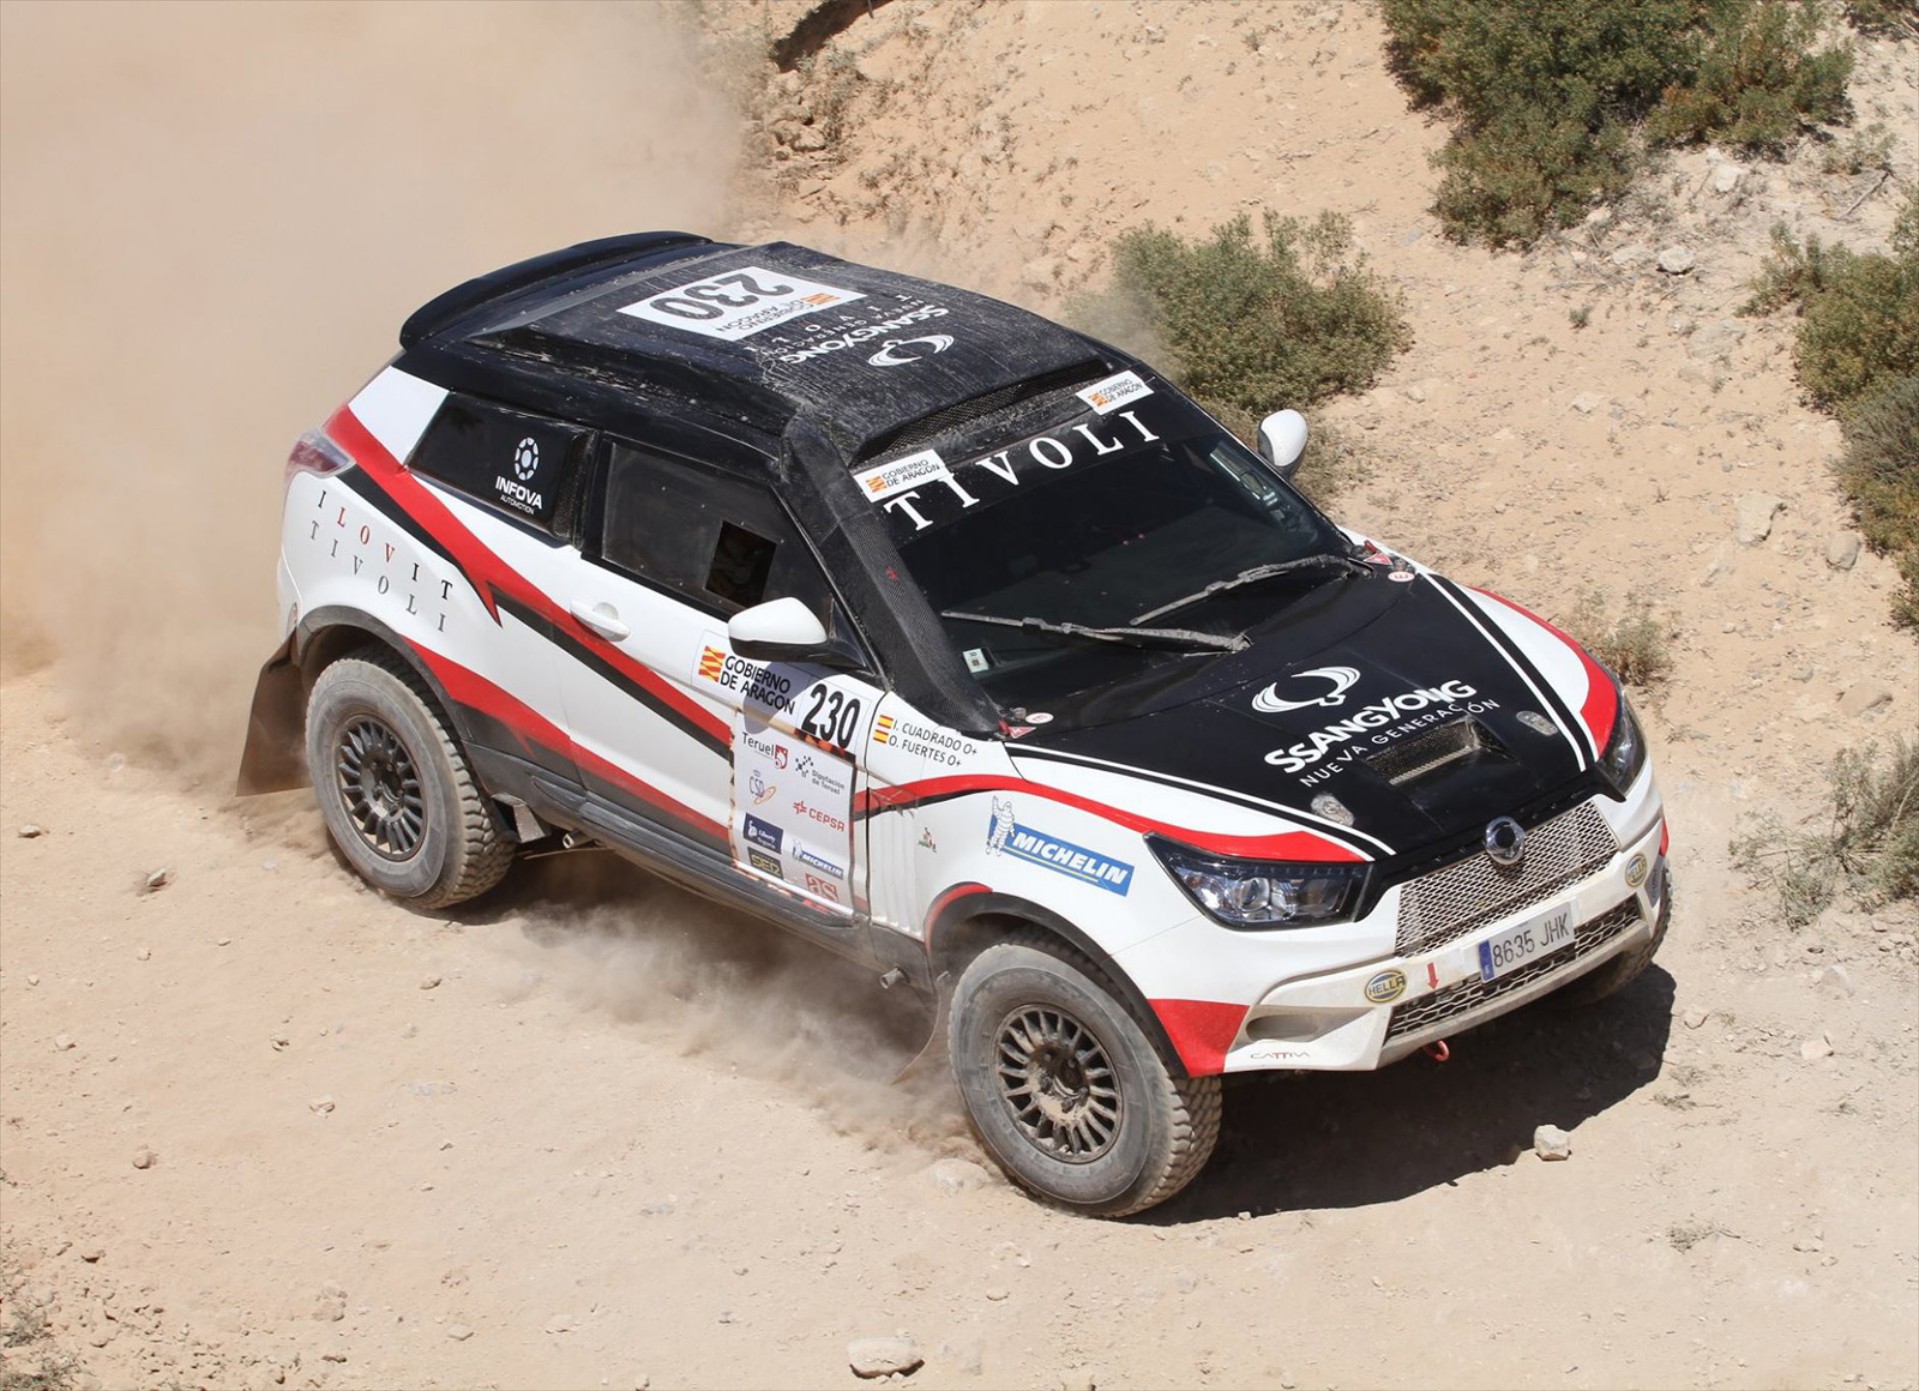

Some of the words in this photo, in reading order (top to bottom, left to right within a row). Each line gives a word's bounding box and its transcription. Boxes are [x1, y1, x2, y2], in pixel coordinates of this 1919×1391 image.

[649, 273, 795, 320] 230
[780, 304, 950, 364] SSANGYONG
[882, 459, 929, 480] GOBIERNO
[883, 411, 1160, 531] TIVOLI
[886, 477, 901, 487] DE
[902, 463, 941, 481] ARAGON
[494, 475, 542, 510] INFOVA
[500, 494, 535, 515] AUTOMOTION
[720, 671, 738, 690] DE
[740, 680, 796, 715] ARAGON
[724, 655, 791, 693] GOBIERNO
[800, 682, 861, 749] 230
[1264, 679, 1477, 774] SSANGYONG
[742, 732, 775, 757] Teruel
[888, 735, 900, 748] O.
[901, 739, 946, 763] FUERTES
[947, 754, 962, 767] O+
[902, 722, 962, 752] CUADRADO
[962, 742, 978, 756] O+
[1300, 744, 1369, 788] NUEVA
[1371, 698, 1501, 746] GENERACÓN
[808, 807, 845, 832] CEPSA
[1012, 831, 1128, 885] MICHELIN
[1493, 935, 1536, 969] 8635
[1540, 911, 1570, 949] JHK
[1368, 974, 1407, 996] HELLA
